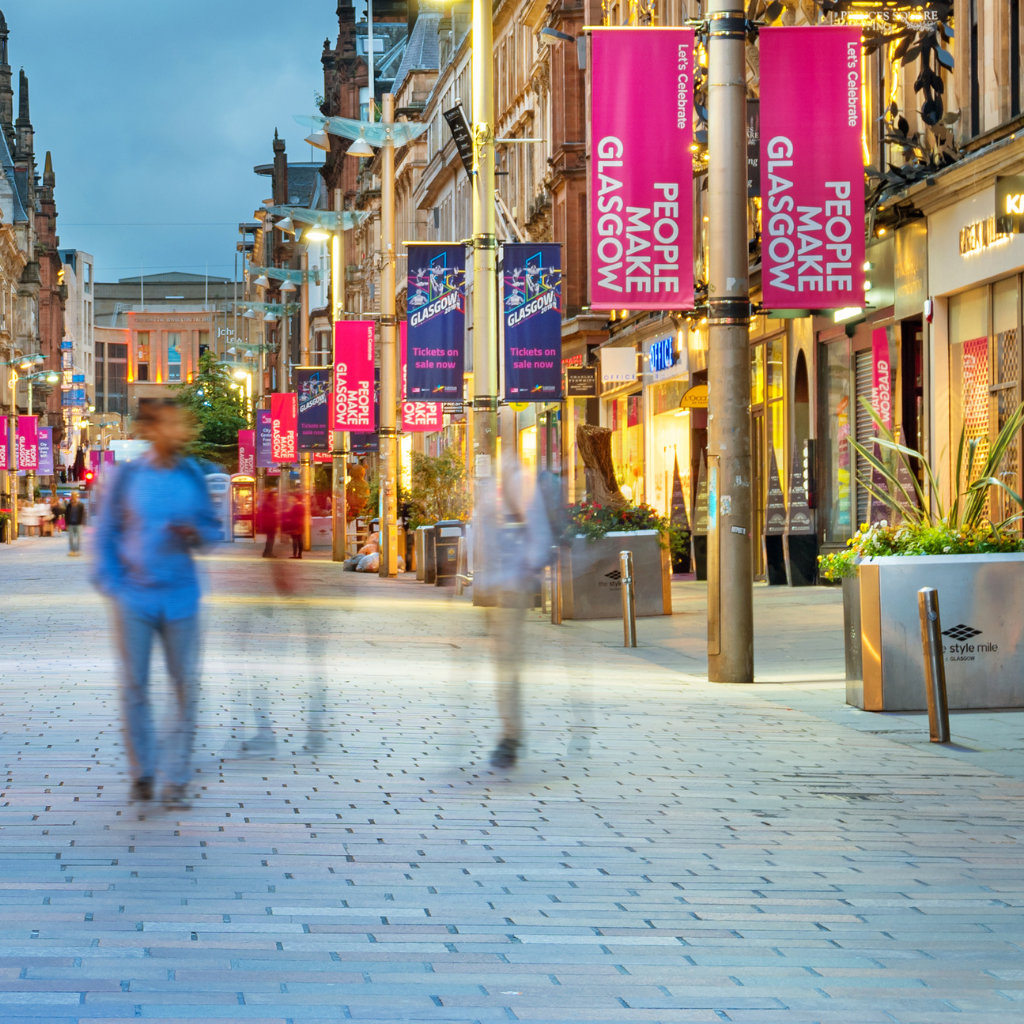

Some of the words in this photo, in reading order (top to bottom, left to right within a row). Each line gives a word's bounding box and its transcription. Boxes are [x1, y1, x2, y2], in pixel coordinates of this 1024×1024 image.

[678, 44, 689, 71] Let's
[847, 41, 858, 69] Let's
[677, 73, 689, 129] Celebrate
[847, 71, 859, 127] Celebrate
[597, 135, 624, 293] GLASGOW
[767, 135, 795, 292] GLASGOW
[626, 206, 651, 293] MAKE
[653, 182, 679, 293] PEOPLE
[797, 205, 824, 292] MAKE
[825, 181, 852, 292] PEOPLE
[410, 290, 458, 327] GLASGOW
[507, 290, 554, 327] GLASGOW
[413, 347, 445, 356] Tickets
[415, 360, 434, 369] sale
[436, 361, 456, 369] now
[510, 347, 542, 356] Tickets
[513, 360, 532, 369] sale
[534, 361, 553, 369] now
[650, 336, 674, 373] OFFICE
[300, 393, 326, 412] GLASGOW
[336, 363, 347, 425] GLASGOW
[348, 390, 358, 425] MAKE
[358, 381, 369, 425] PEOPLE
[950, 643, 975, 654] style
[977, 642, 998, 652] mile
